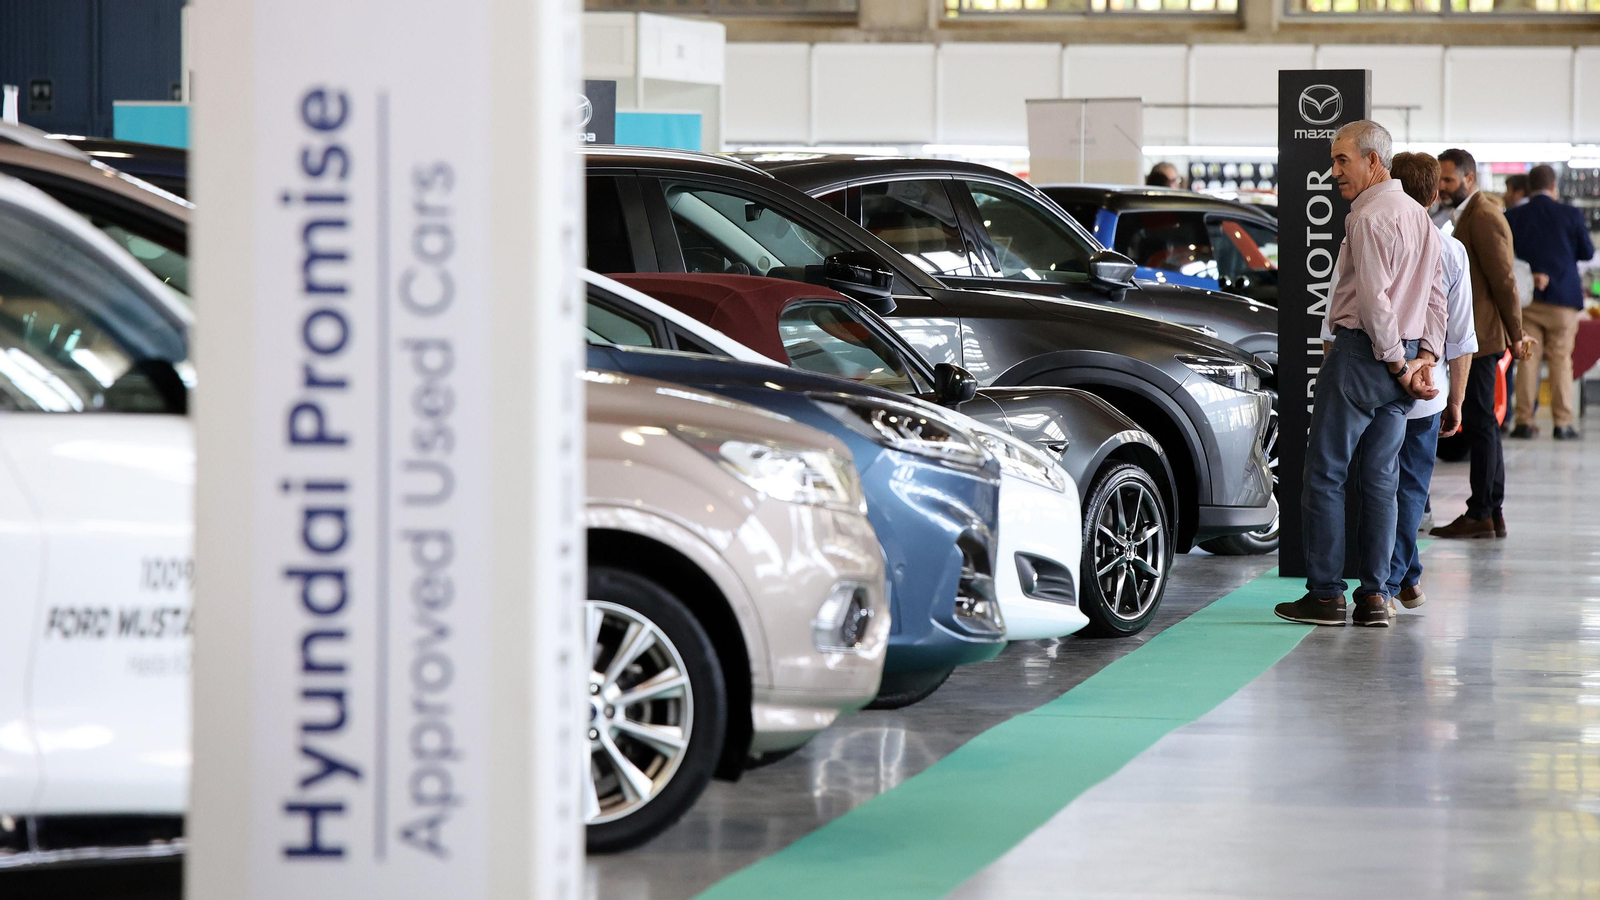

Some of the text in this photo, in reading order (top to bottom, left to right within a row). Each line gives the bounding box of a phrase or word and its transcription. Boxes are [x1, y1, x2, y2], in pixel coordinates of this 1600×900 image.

[1306, 166, 1333, 316] MOTOR
[46, 607, 110, 638] FORD
[279, 86, 365, 864] Hyundai Promise
[396, 161, 465, 862] Approved Used Cars
